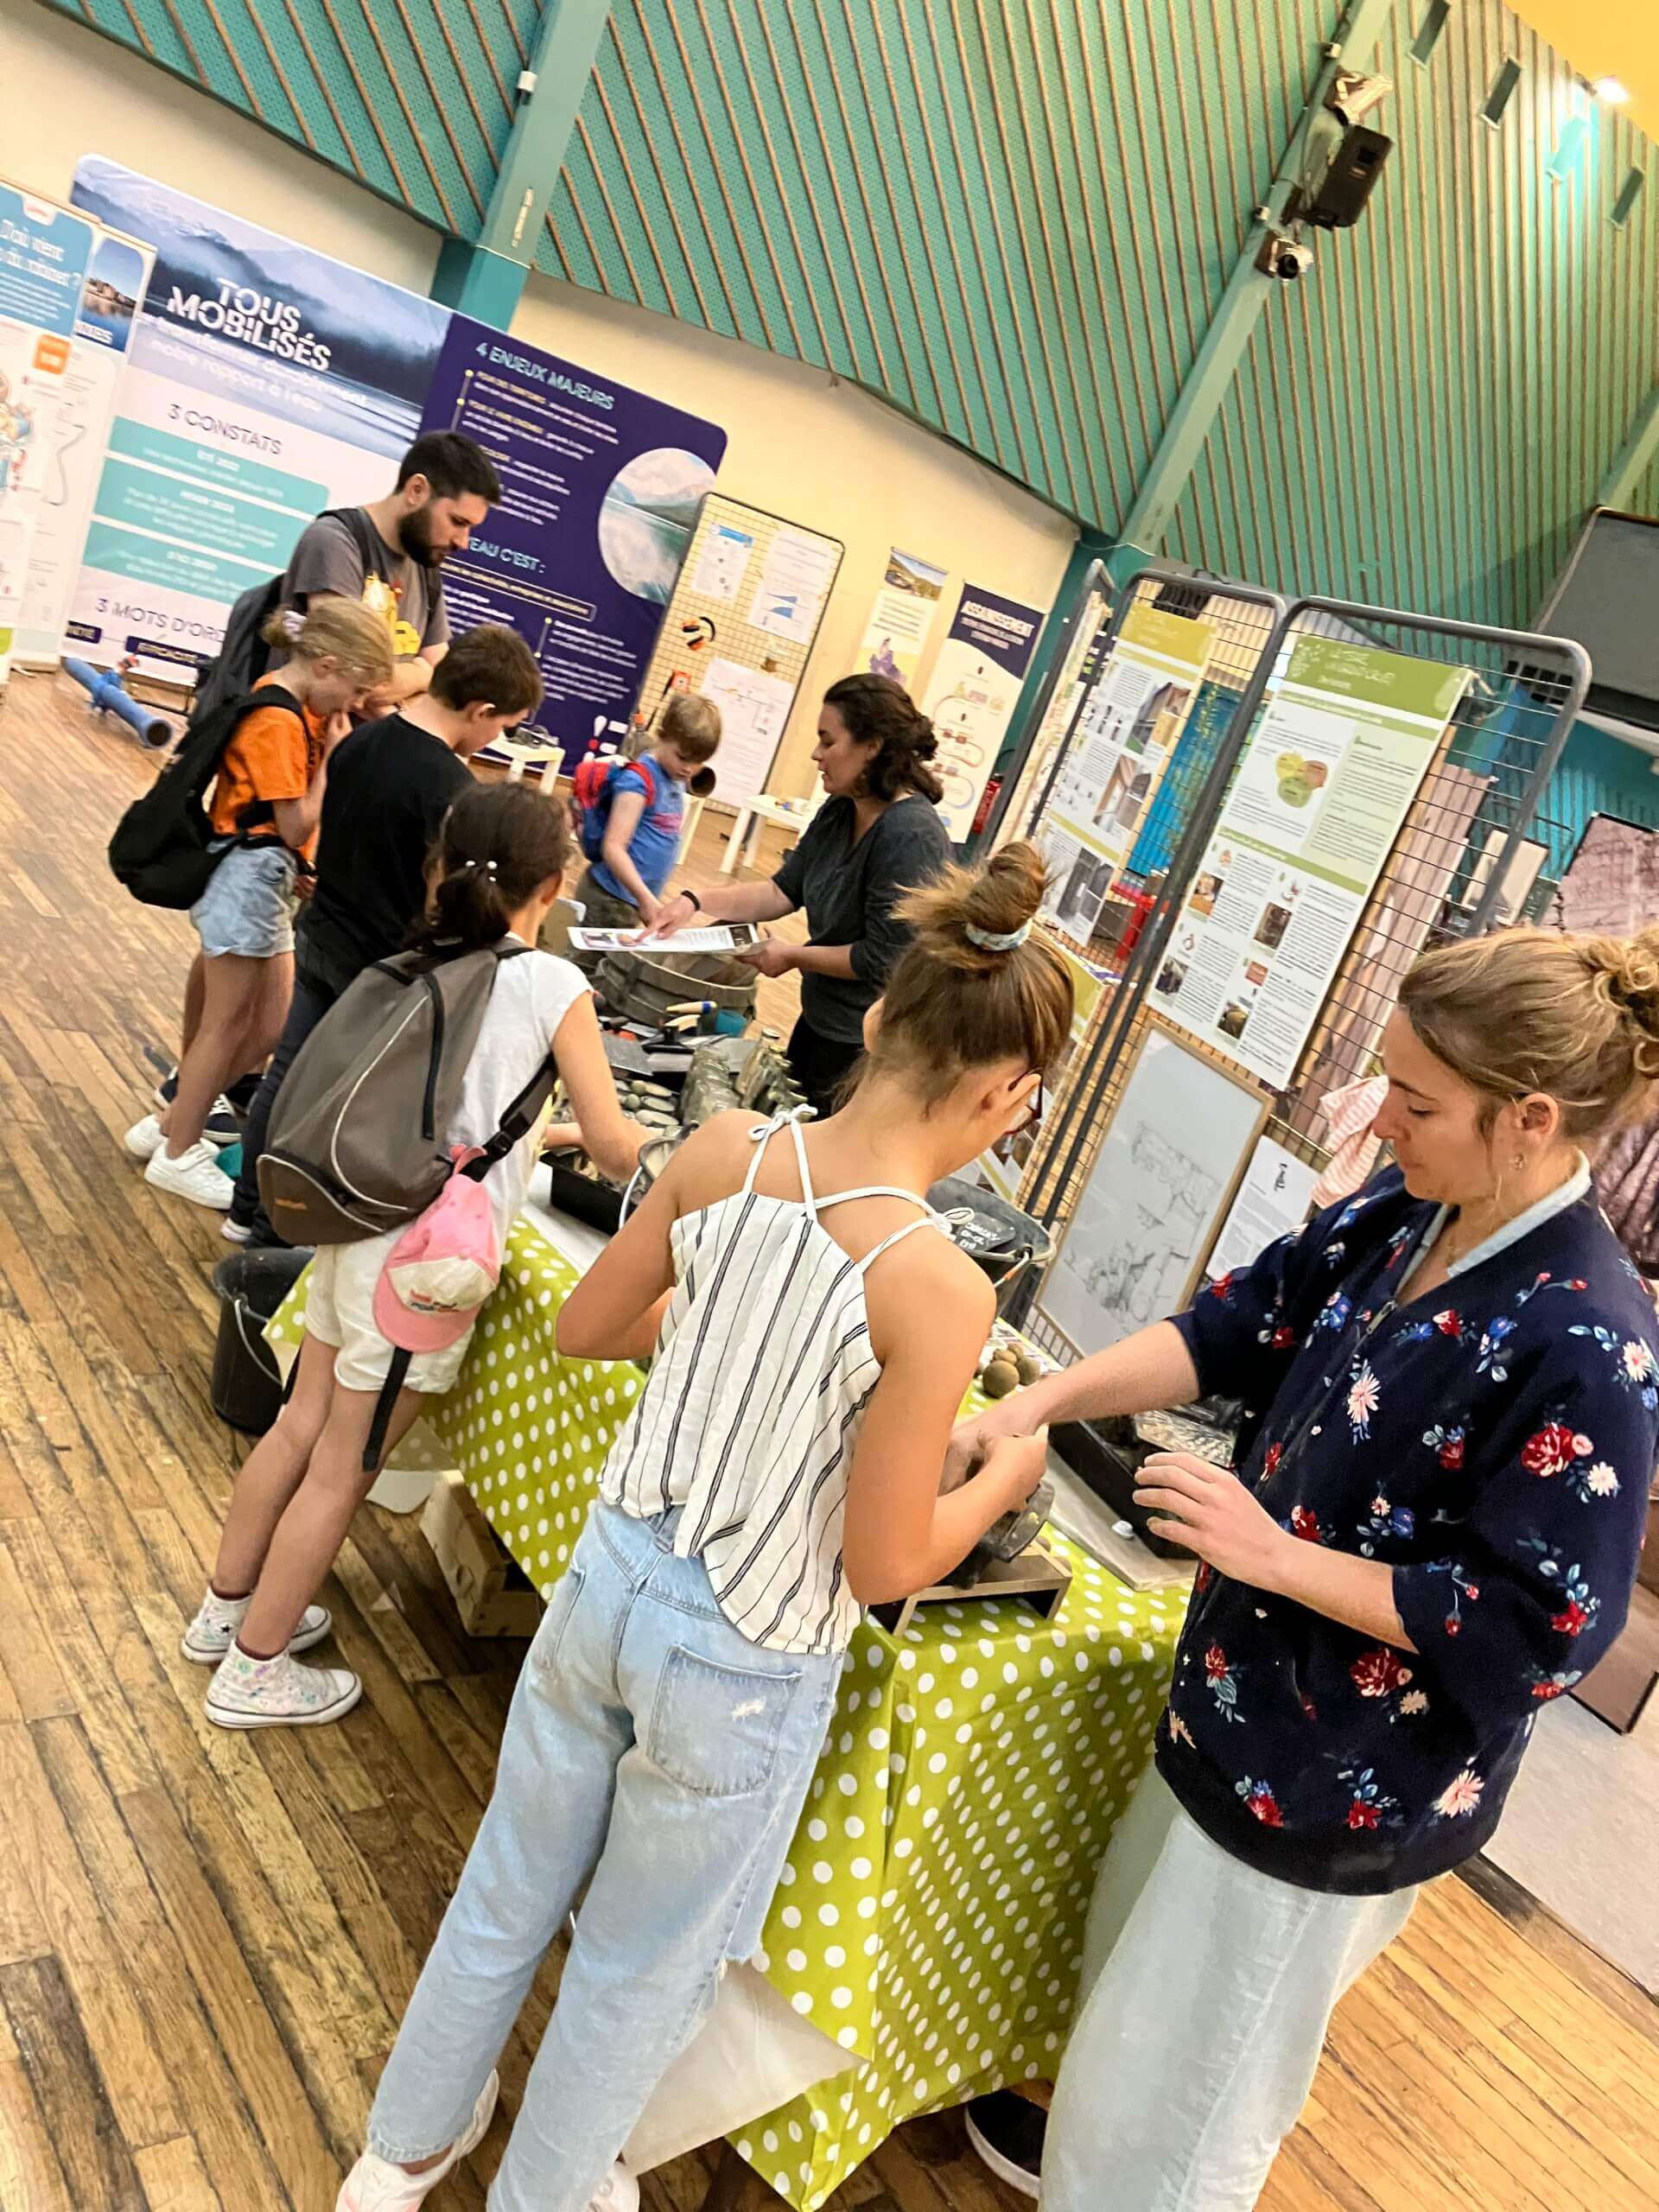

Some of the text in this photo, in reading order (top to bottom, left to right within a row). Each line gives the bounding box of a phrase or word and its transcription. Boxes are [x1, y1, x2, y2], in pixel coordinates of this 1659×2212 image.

[166, 286, 333, 372] MOBILISÉS
[217, 277, 302, 334] TOUS
[475, 342, 488, 357] 4
[489, 346, 549, 382] ENJEUX
[547, 372, 615, 410] MAJEURS
[168, 403, 283, 455] 3 CONSTATS
[94, 597, 228, 643] 3 MOTS D'ORD
